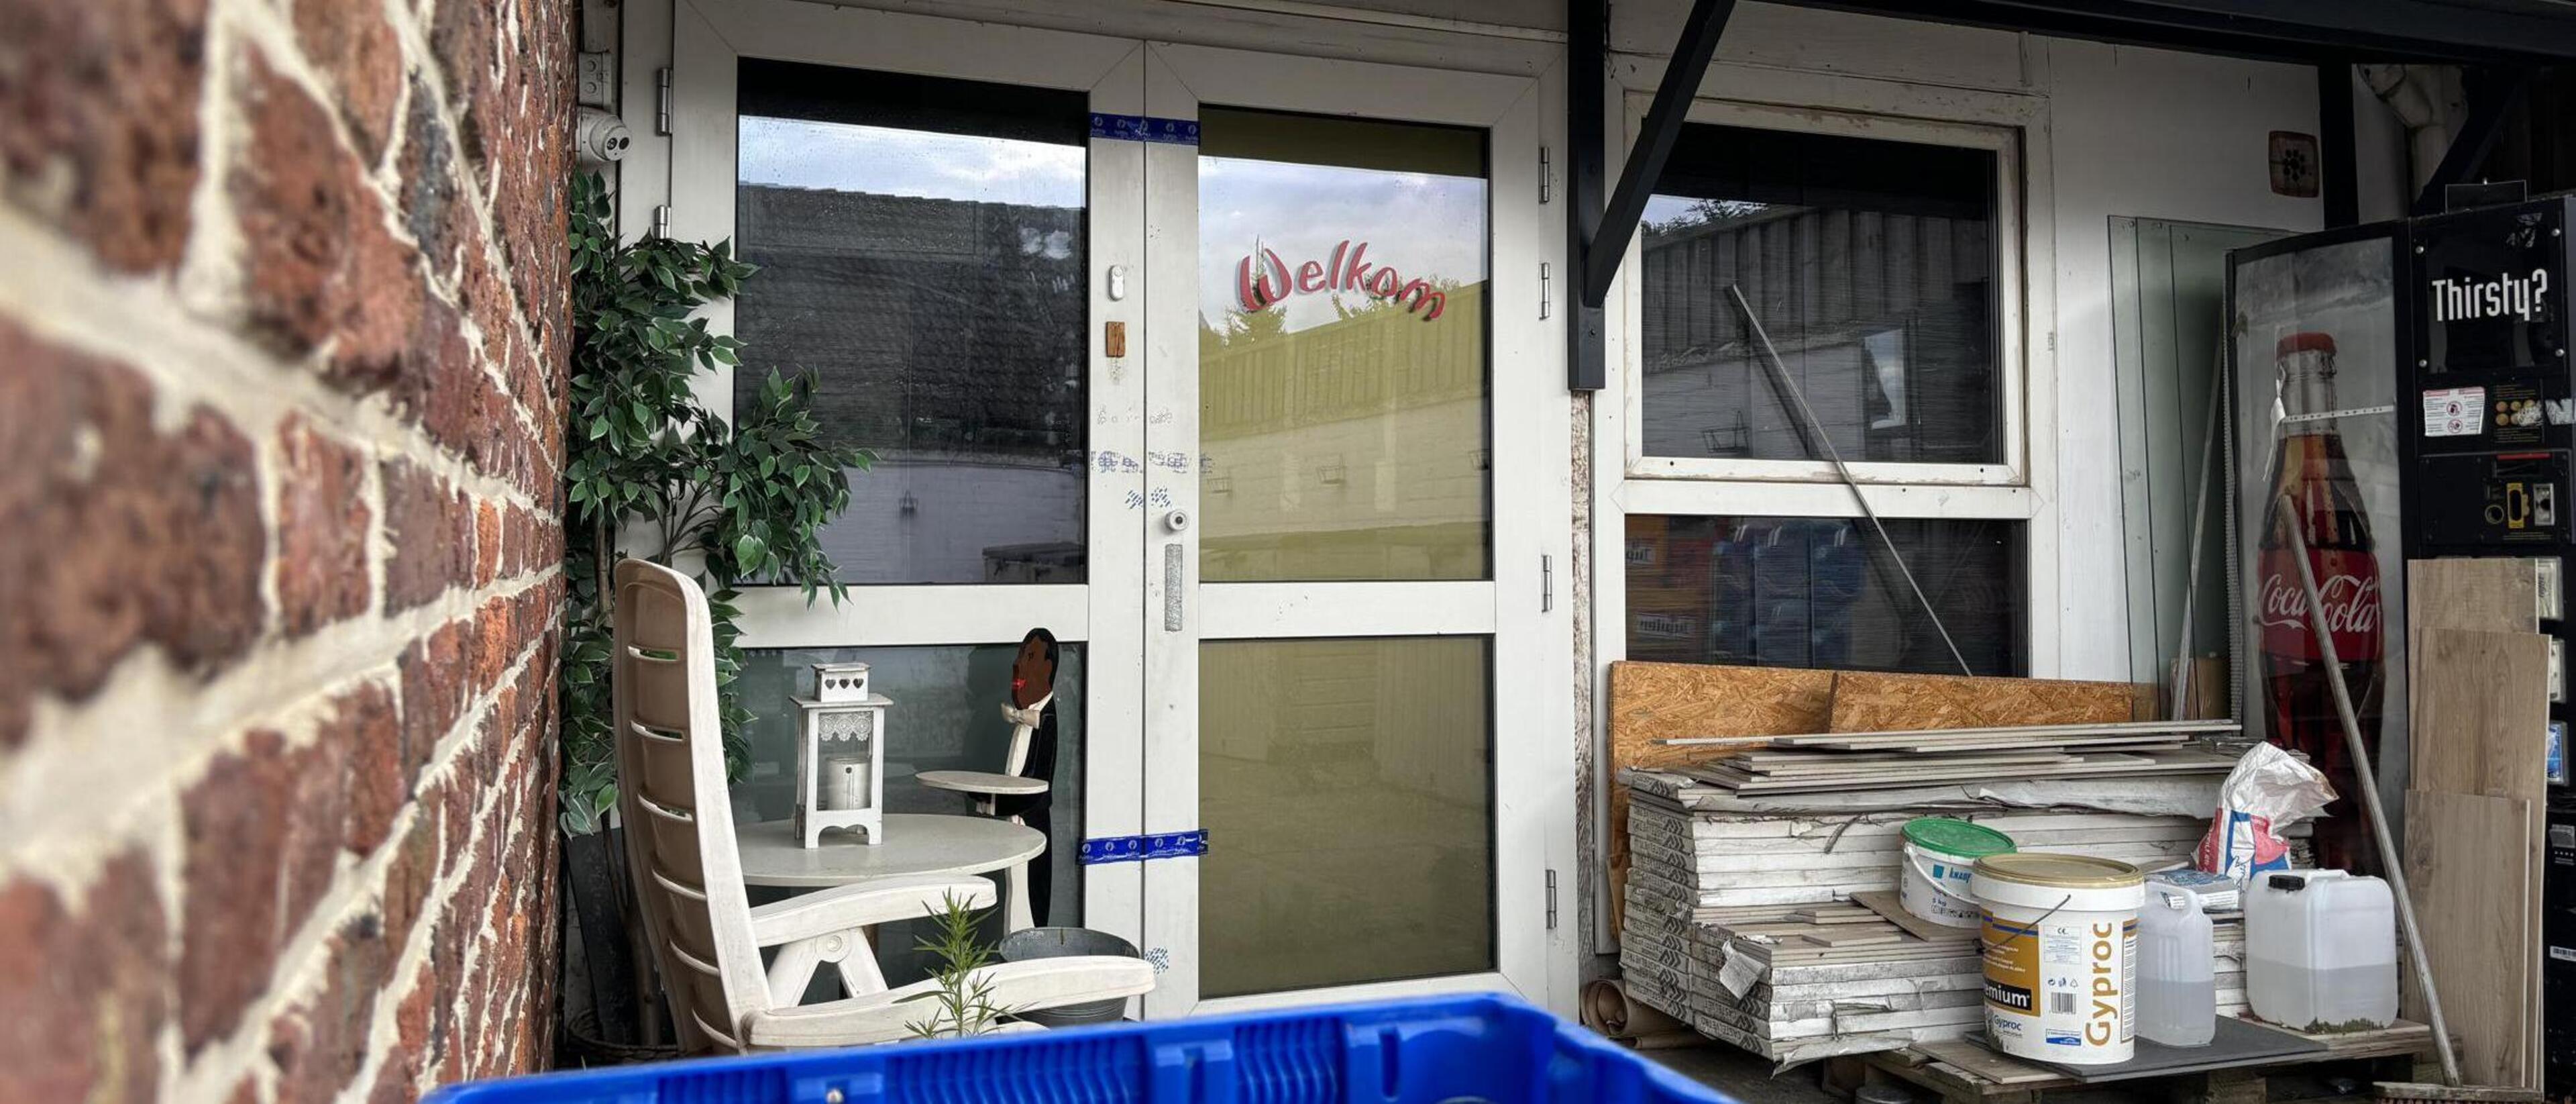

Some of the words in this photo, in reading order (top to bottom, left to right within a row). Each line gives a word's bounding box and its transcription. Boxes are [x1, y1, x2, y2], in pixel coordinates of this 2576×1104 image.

[1237, 239, 1446, 320] Welkom
[2431, 268, 2547, 321] Thirsty?
[2260, 574, 2379, 632] CocaCola
[1984, 983, 2028, 1007] emium
[2086, 923, 2118, 1046] Gyproc
[1994, 1014, 2022, 1032] Gyproc
